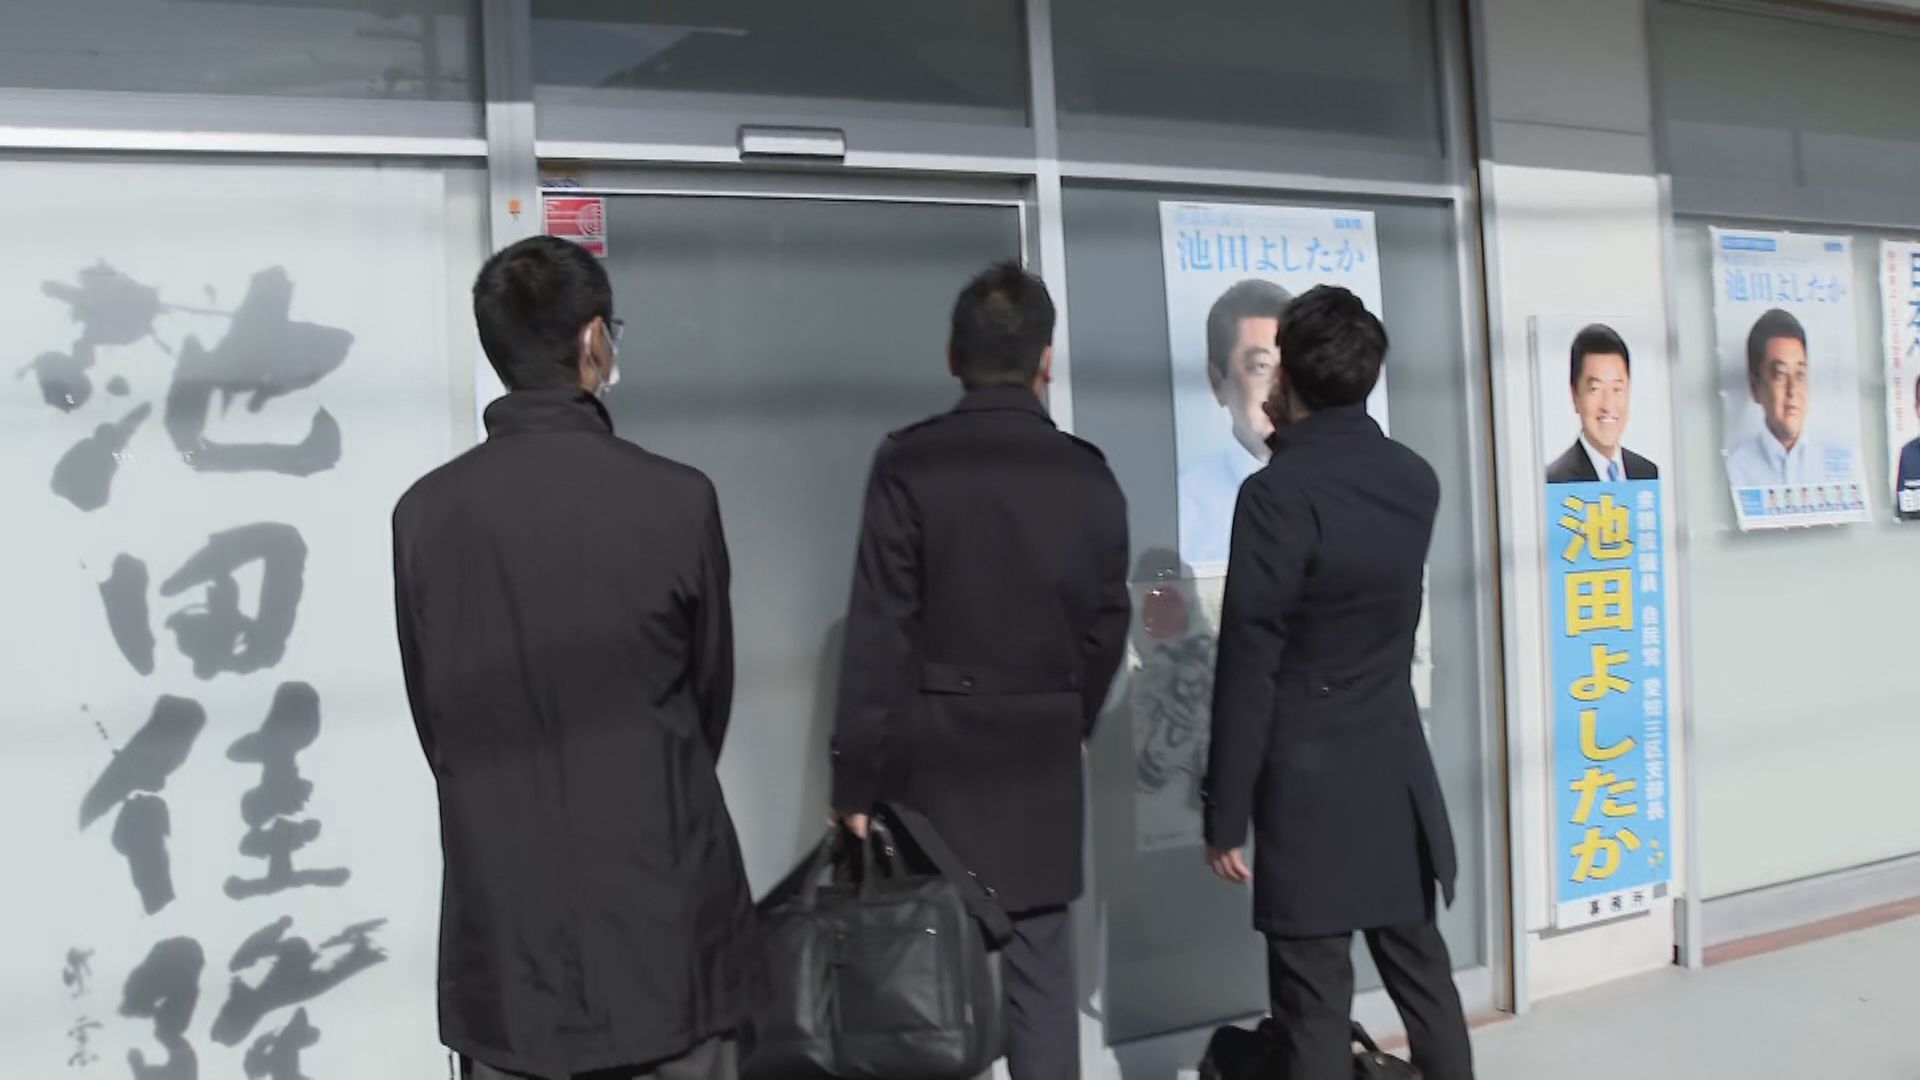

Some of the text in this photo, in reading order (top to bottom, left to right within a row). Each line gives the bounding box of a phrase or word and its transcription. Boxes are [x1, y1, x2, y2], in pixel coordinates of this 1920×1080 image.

[1177, 229, 1365, 272] 池田よしたか
[1559, 493, 1642, 883] 池田よしたか
